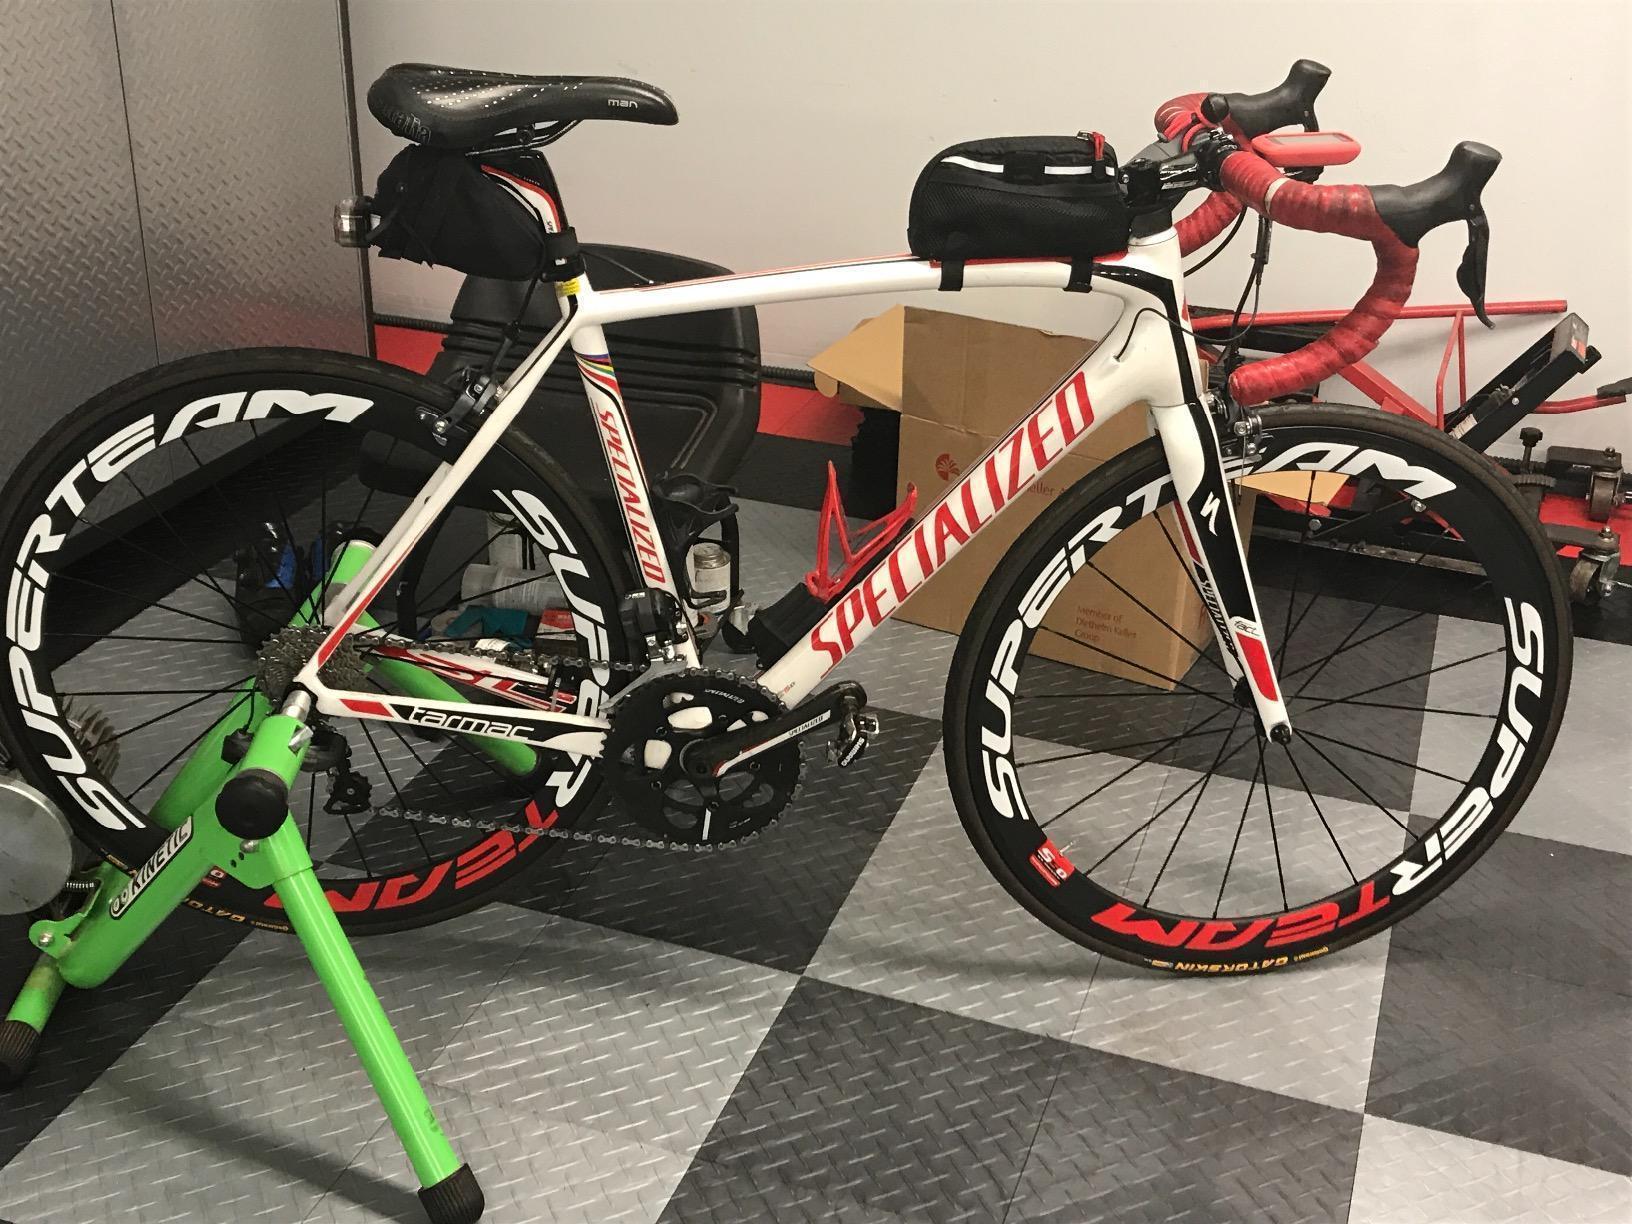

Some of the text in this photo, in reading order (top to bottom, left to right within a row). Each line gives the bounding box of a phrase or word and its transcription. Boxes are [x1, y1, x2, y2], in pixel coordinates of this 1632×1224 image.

[607, 98, 638, 109] man
[598, 410, 666, 584] SPECIALIZED
[811, 371, 1094, 678] SPECIALIZED
[6, 389, 374, 830] SUPERTEAM
[409, 706, 534, 740] tarmac
[131, 823, 189, 893] KINETIC
[1175, 955, 1289, 973] GATORSKIN
